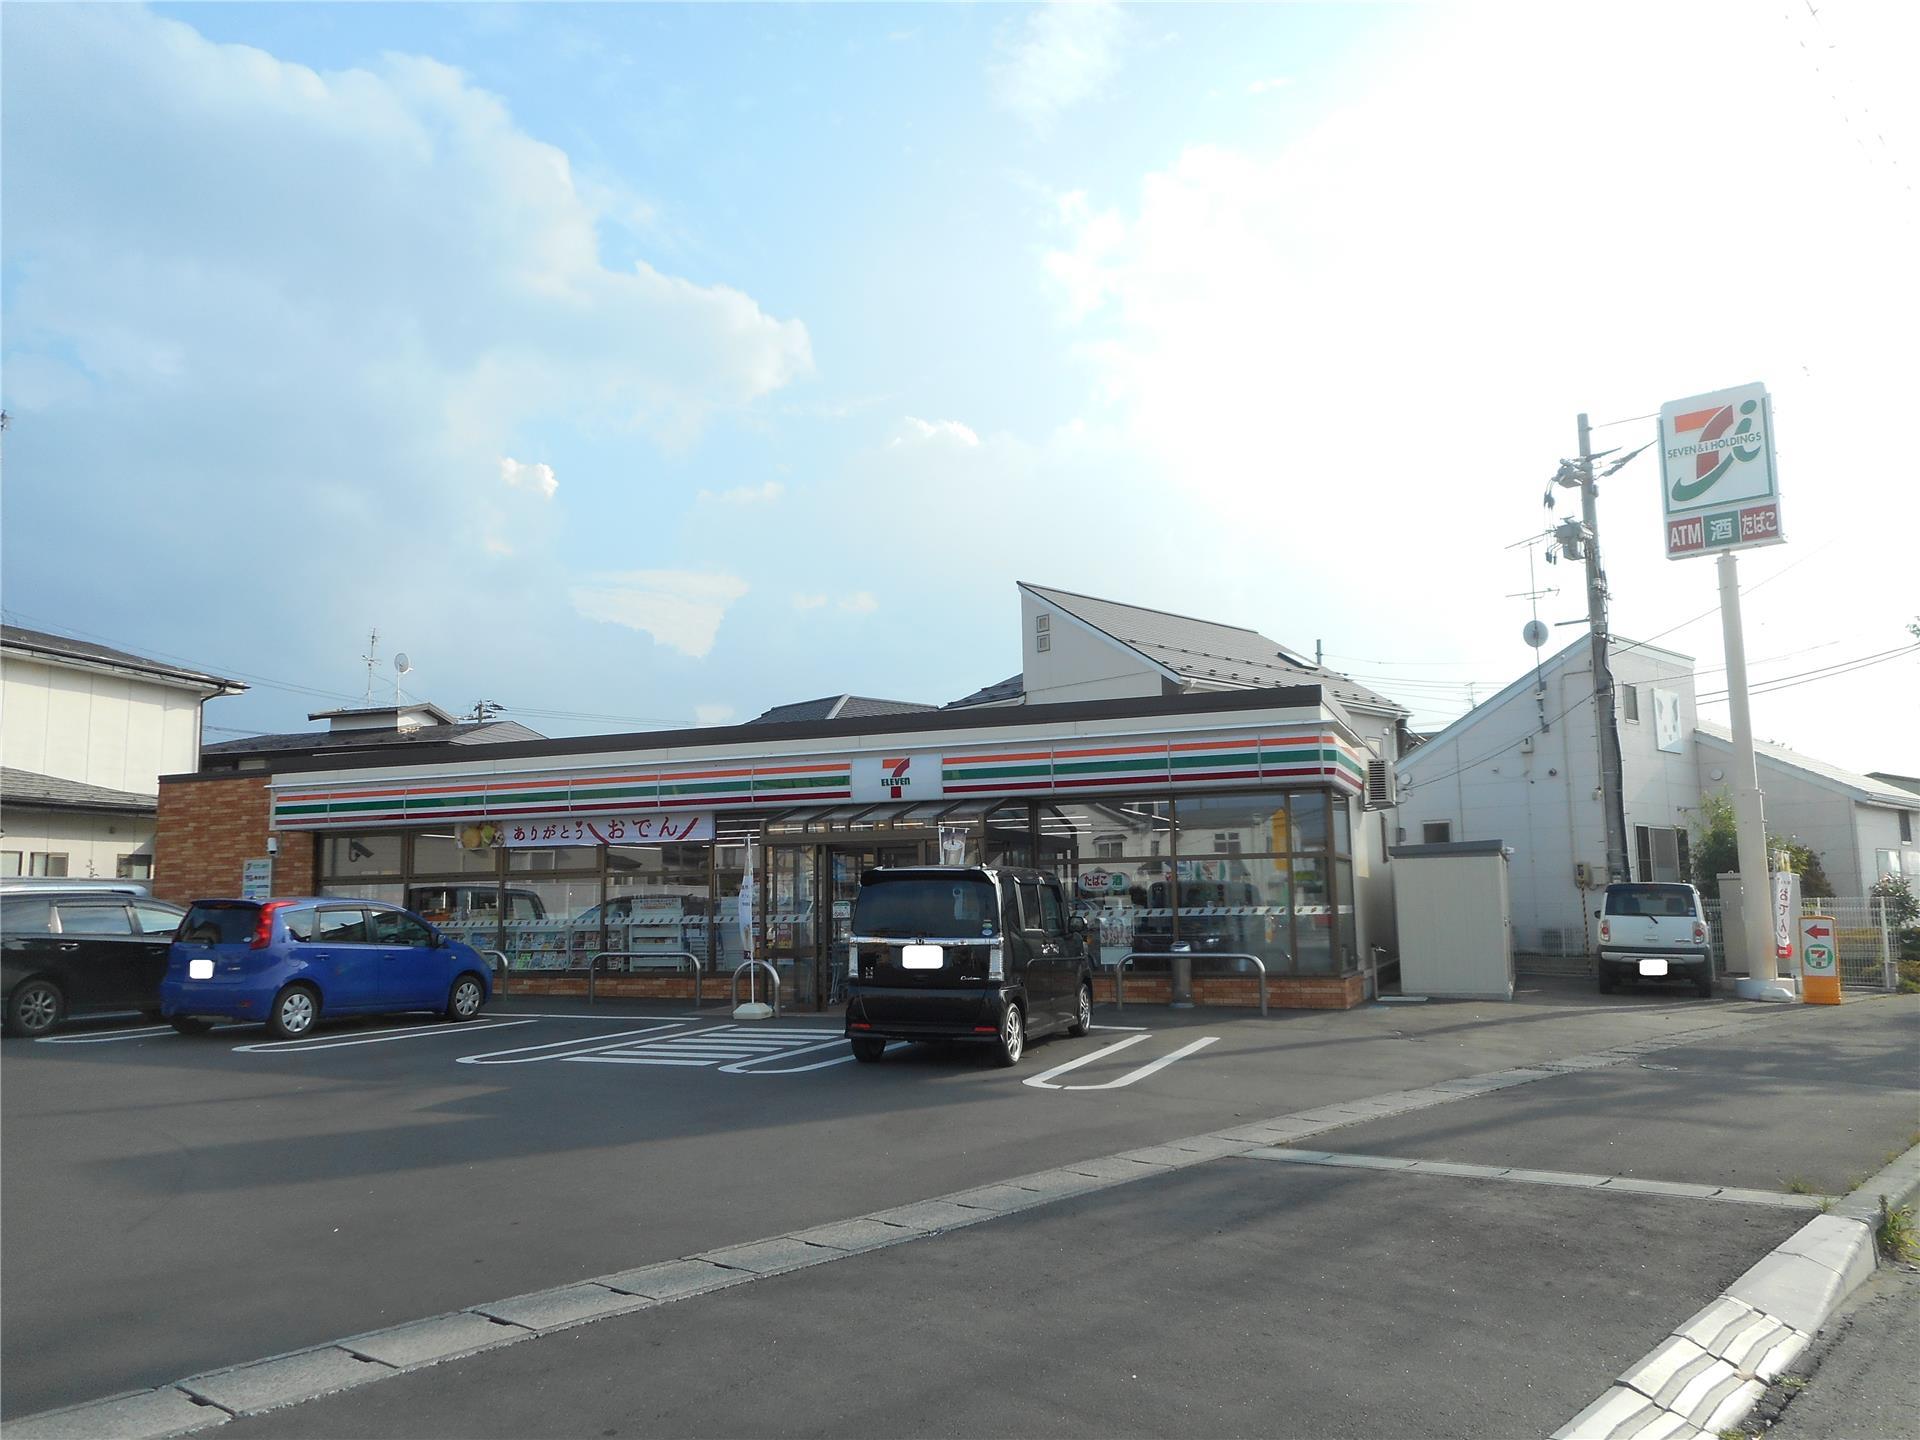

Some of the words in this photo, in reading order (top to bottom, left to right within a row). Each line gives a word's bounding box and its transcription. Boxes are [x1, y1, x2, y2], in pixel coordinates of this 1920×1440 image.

[1710, 431, 1762, 450] HOLDINGS
[1670, 522, 1702, 548] ATM
[1710, 517, 1733, 541] 酒
[1742, 511, 1777, 535] たばこ
[513, 823, 585, 842] ありがとう
[608, 816, 678, 839] おでん
[1084, 874, 1108, 887] たばこ
